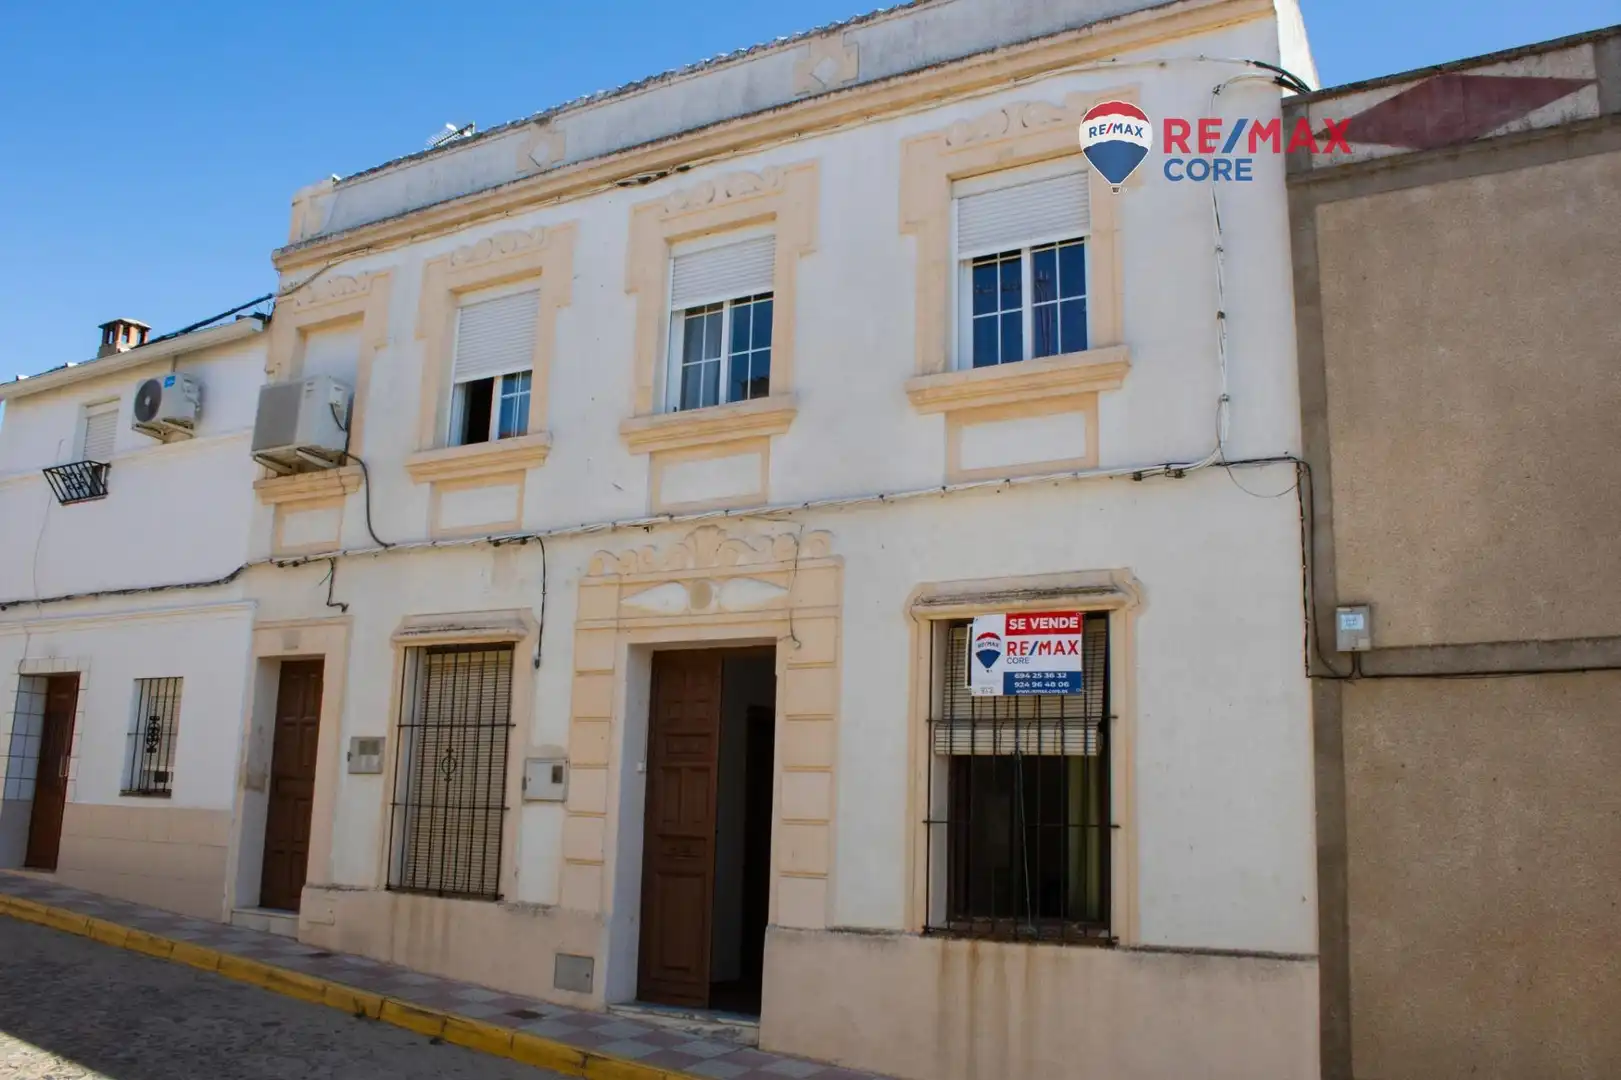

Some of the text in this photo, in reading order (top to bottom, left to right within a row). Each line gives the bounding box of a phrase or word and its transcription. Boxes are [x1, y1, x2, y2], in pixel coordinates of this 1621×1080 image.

[1009, 617, 1078, 630] SE VENDE
[1006, 640, 1079, 656] RE/MAX
